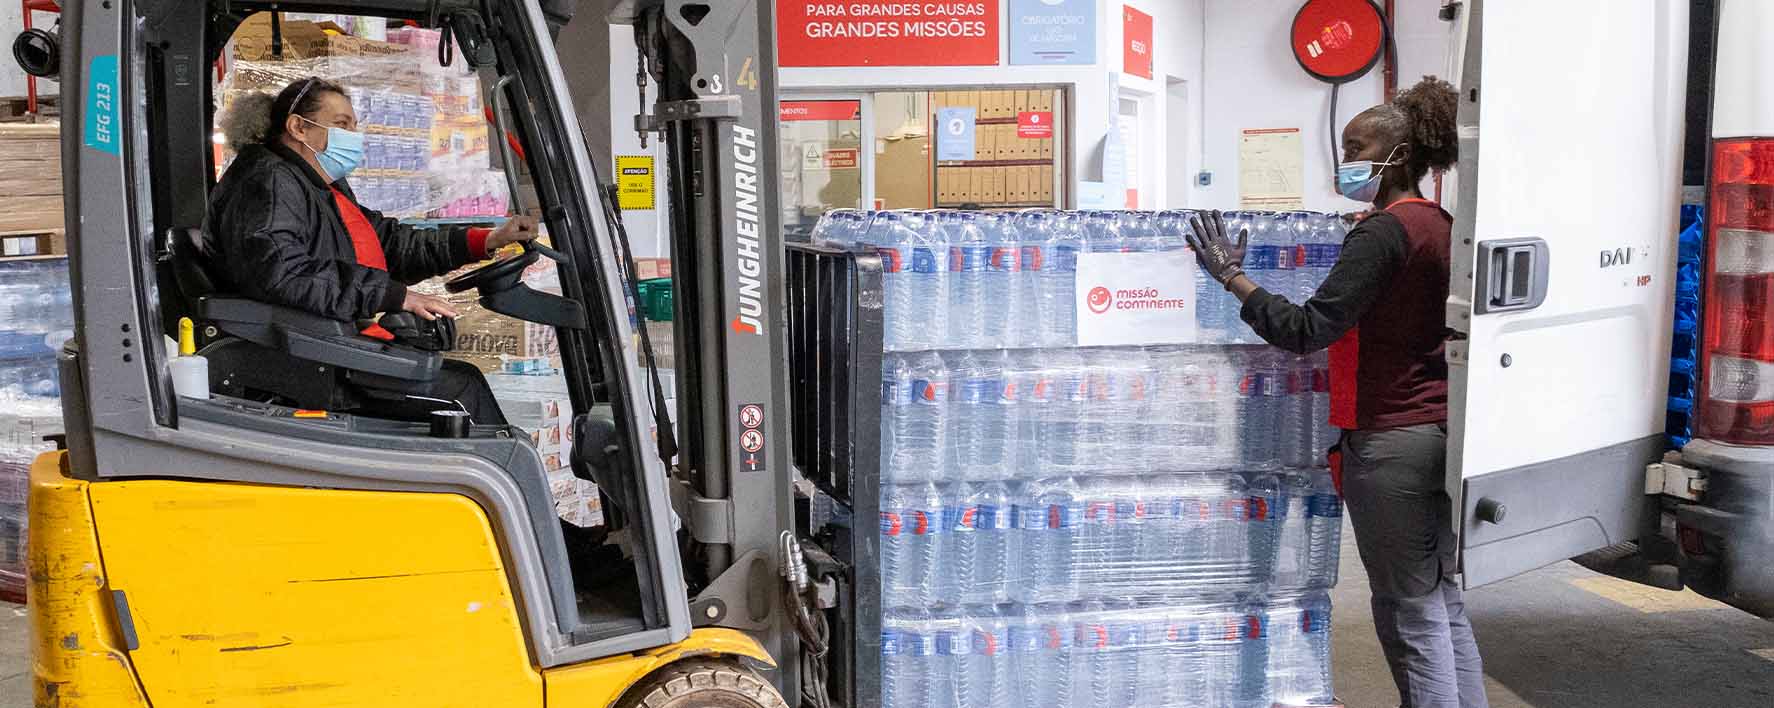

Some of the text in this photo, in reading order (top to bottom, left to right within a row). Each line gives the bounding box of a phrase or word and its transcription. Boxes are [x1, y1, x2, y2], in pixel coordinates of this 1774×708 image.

[806, 4, 984, 16] PARA GRANDES CAUSAS
[806, 19, 985, 37] GRANDES MISSÕES
[737, 57, 758, 90] 4
[97, 82, 111, 143] EFG 213
[733, 124, 763, 336] JUNGHEINRICH
[1116, 287, 1159, 298] MISSÃO
[1116, 299, 1185, 310] CONTINENTE
